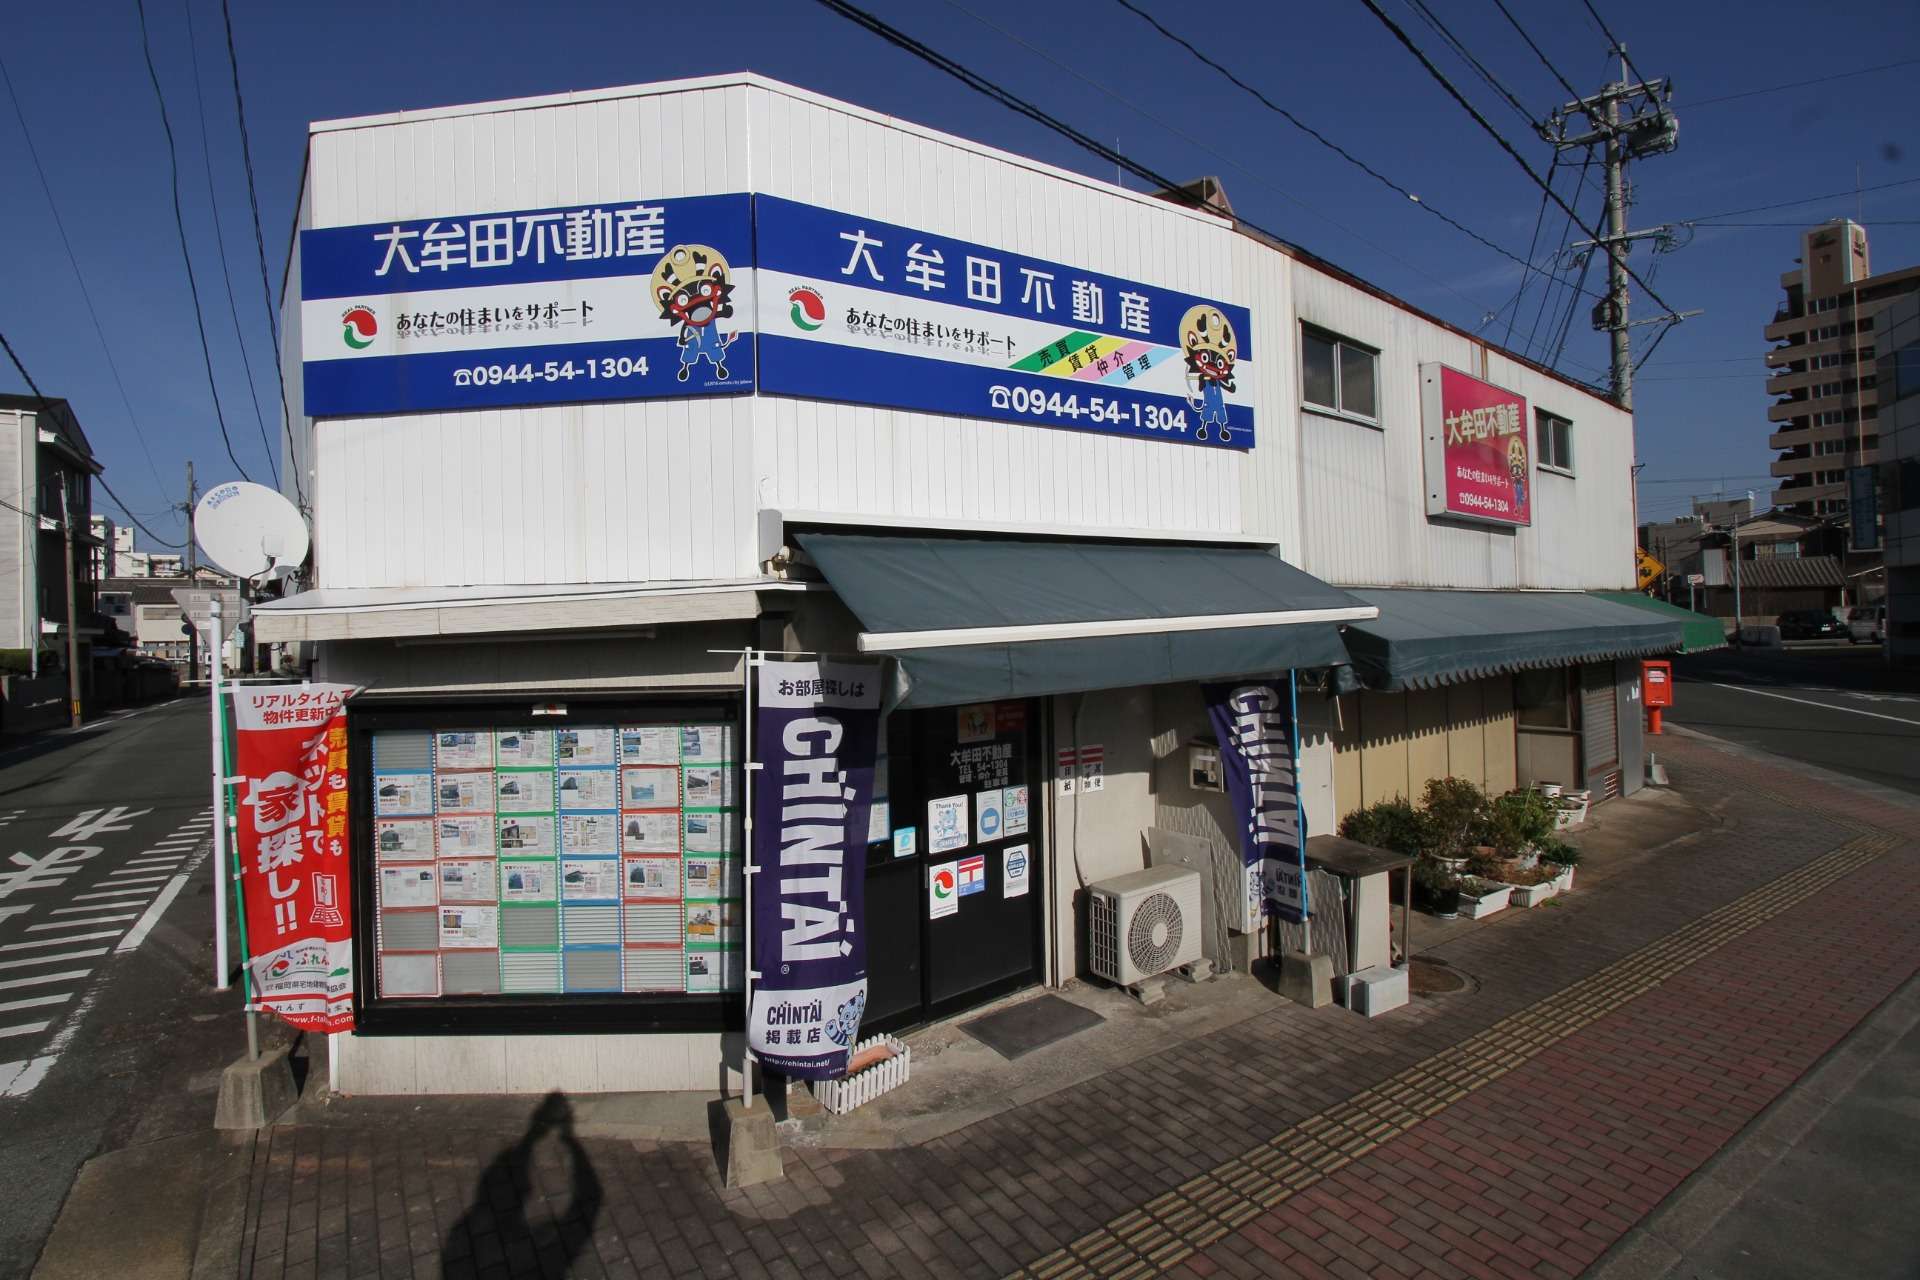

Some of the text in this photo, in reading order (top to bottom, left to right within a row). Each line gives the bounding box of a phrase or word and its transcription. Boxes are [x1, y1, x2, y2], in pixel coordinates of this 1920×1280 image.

[373, 205, 665, 277] 大牟田不動産
[839, 229, 1152, 334] 大牟田不動産
[396, 299, 594, 331] あなたの住まいをサポート
[845, 307, 1017, 352] あなたの住まいをサポート
[1039, 339, 1070, 368] 売買
[1097, 350, 1125, 377] 仲介
[1122, 353, 1152, 380] 管理
[472, 356, 649, 387] 0944-54-1304
[1011, 386, 1188, 433] 0944-54-1304
[1445, 402, 1521, 447] 大牟田不動産
[778, 679, 865, 697] お部屋探しは
[767, 999, 822, 1025] CHINTAI
[766, 1028, 821, 1044] 掲載店
